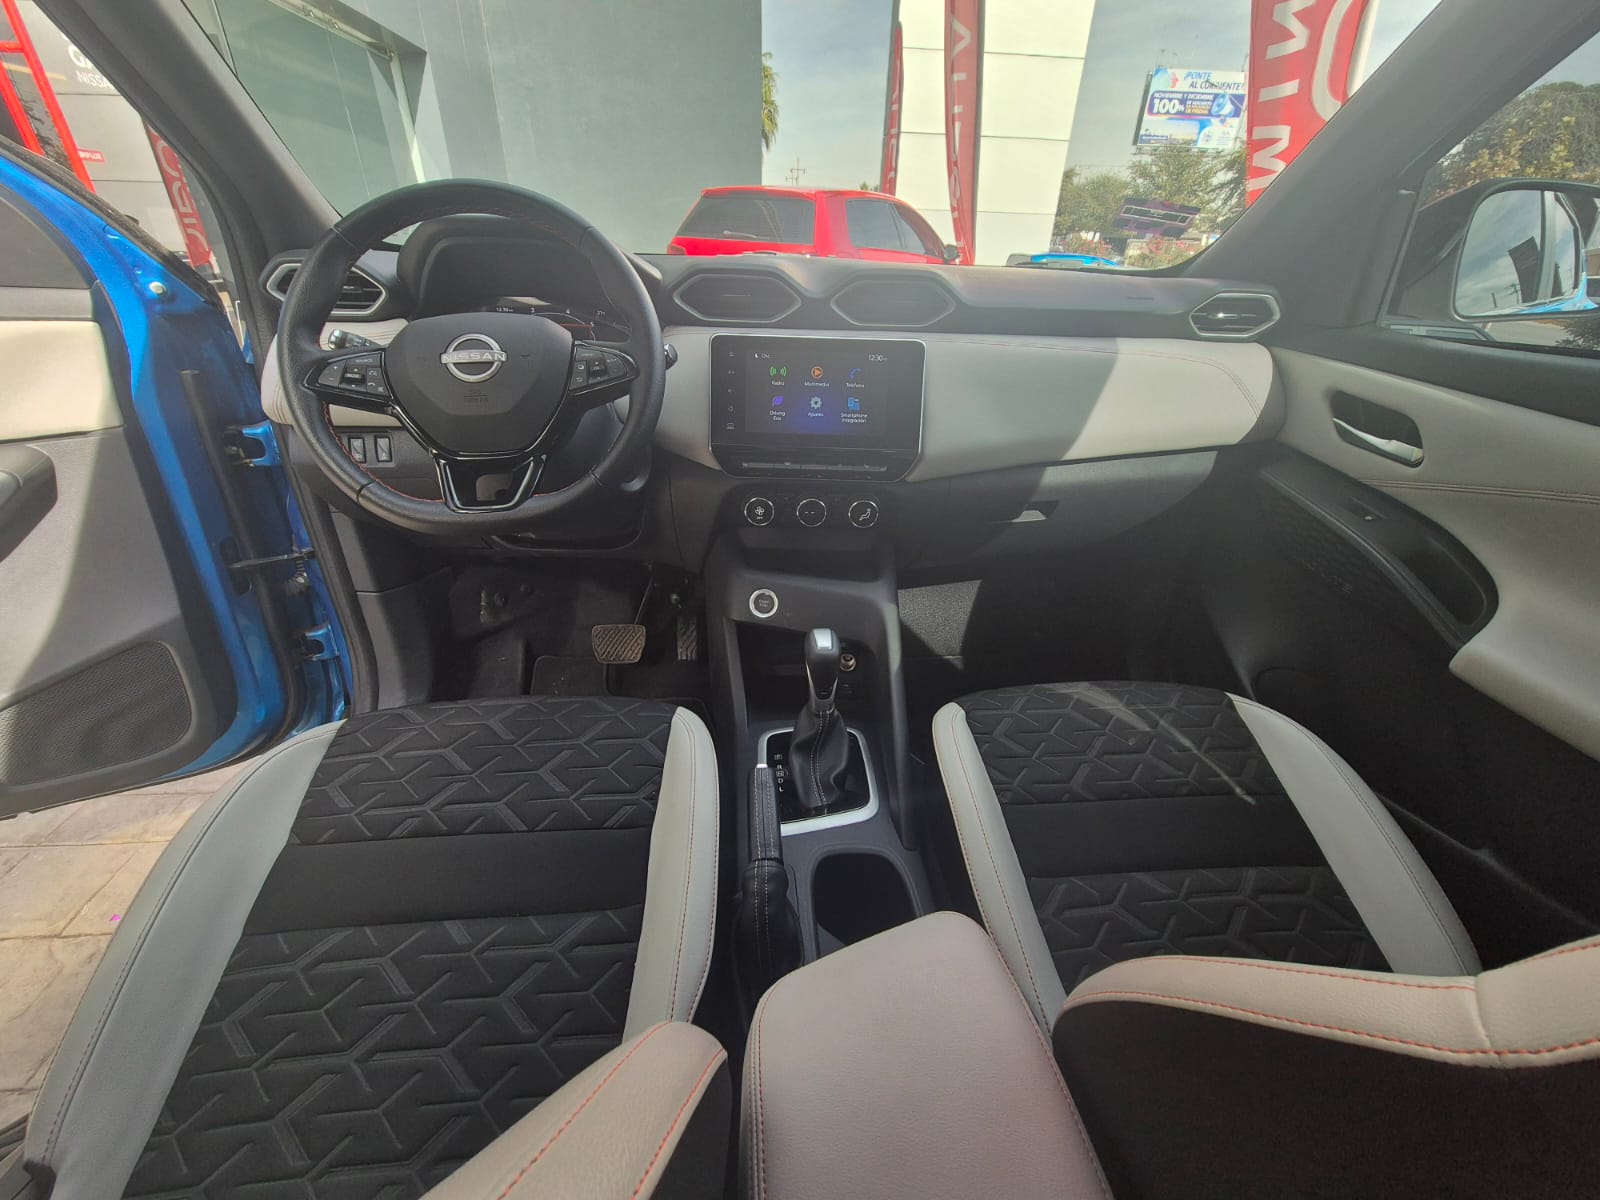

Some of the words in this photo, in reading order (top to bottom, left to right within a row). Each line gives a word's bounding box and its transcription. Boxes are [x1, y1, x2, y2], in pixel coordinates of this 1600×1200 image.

[1189, 81, 1199, 89] AL
[1153, 98, 1184, 114] 100%
[441, 351, 507, 364] NISSAN
